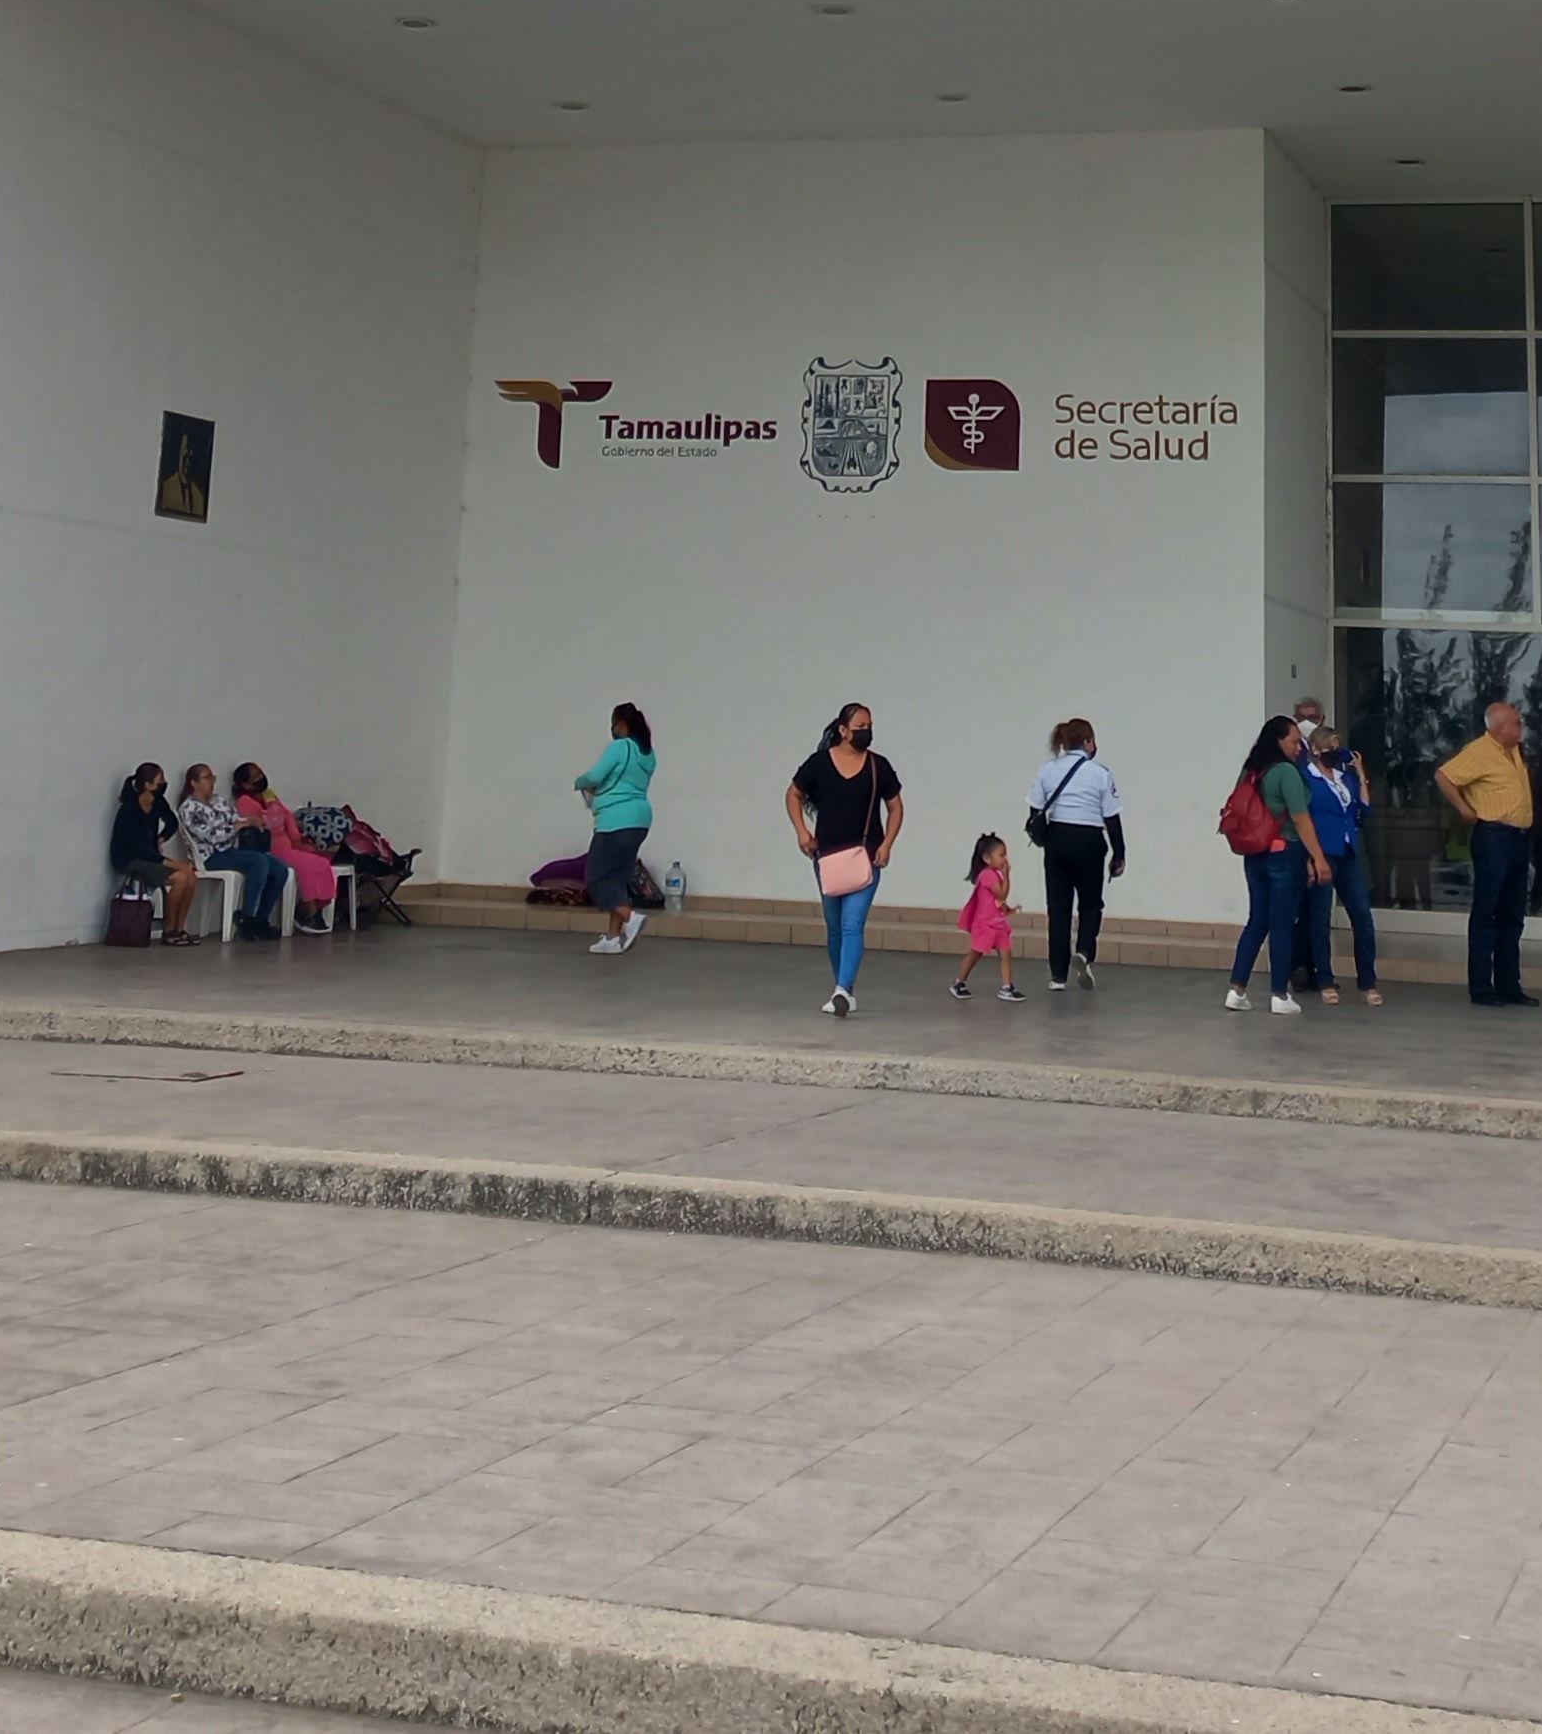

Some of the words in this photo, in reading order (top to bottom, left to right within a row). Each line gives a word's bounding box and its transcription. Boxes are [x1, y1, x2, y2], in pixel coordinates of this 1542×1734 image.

[1054, 393, 1239, 425] Secretaría
[598, 412, 779, 448] Tamaulipas
[1054, 428, 1099, 460] de
[1109, 428, 1210, 461] Salud
[601, 445, 655, 458] Gobierno
[656, 446, 675, 458] del
[677, 446, 718, 458] Estado
